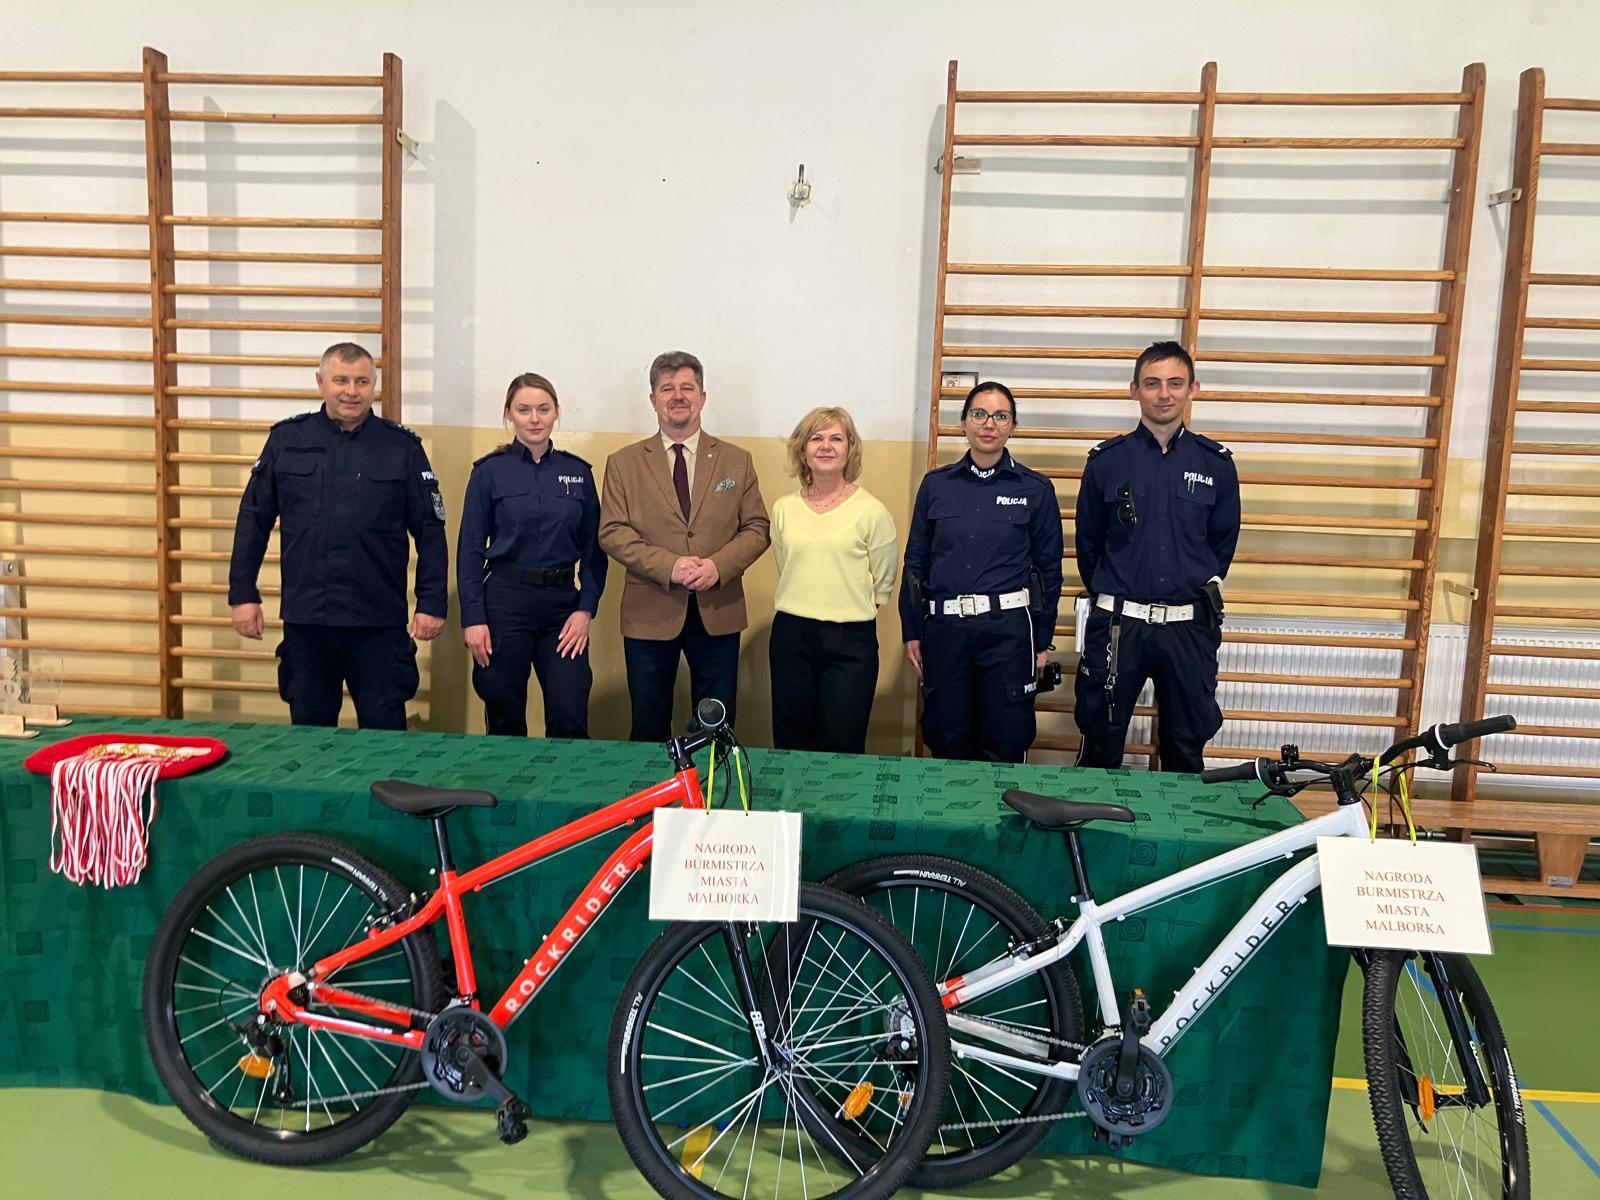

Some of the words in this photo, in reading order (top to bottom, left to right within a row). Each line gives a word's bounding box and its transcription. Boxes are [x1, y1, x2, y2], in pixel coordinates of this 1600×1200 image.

[996, 496, 1027, 505] POLICJA
[695, 843, 756, 854] NAGRODA
[684, 859, 765, 871] BURMISTRZA
[700, 876, 748, 887] MIASTA
[919, 870, 952, 884] TERRAIN
[1364, 870, 1433, 884] NAGRODA
[687, 892, 759, 904] MALBORKA
[1356, 886, 1445, 902] BURMISTRZA
[1376, 904, 1430, 917] MIASTA
[1365, 919, 1445, 935] MALBORKA
[504, 862, 631, 1012] ROCKRIDER
[1159, 900, 1291, 1047] ROCKRIDER
